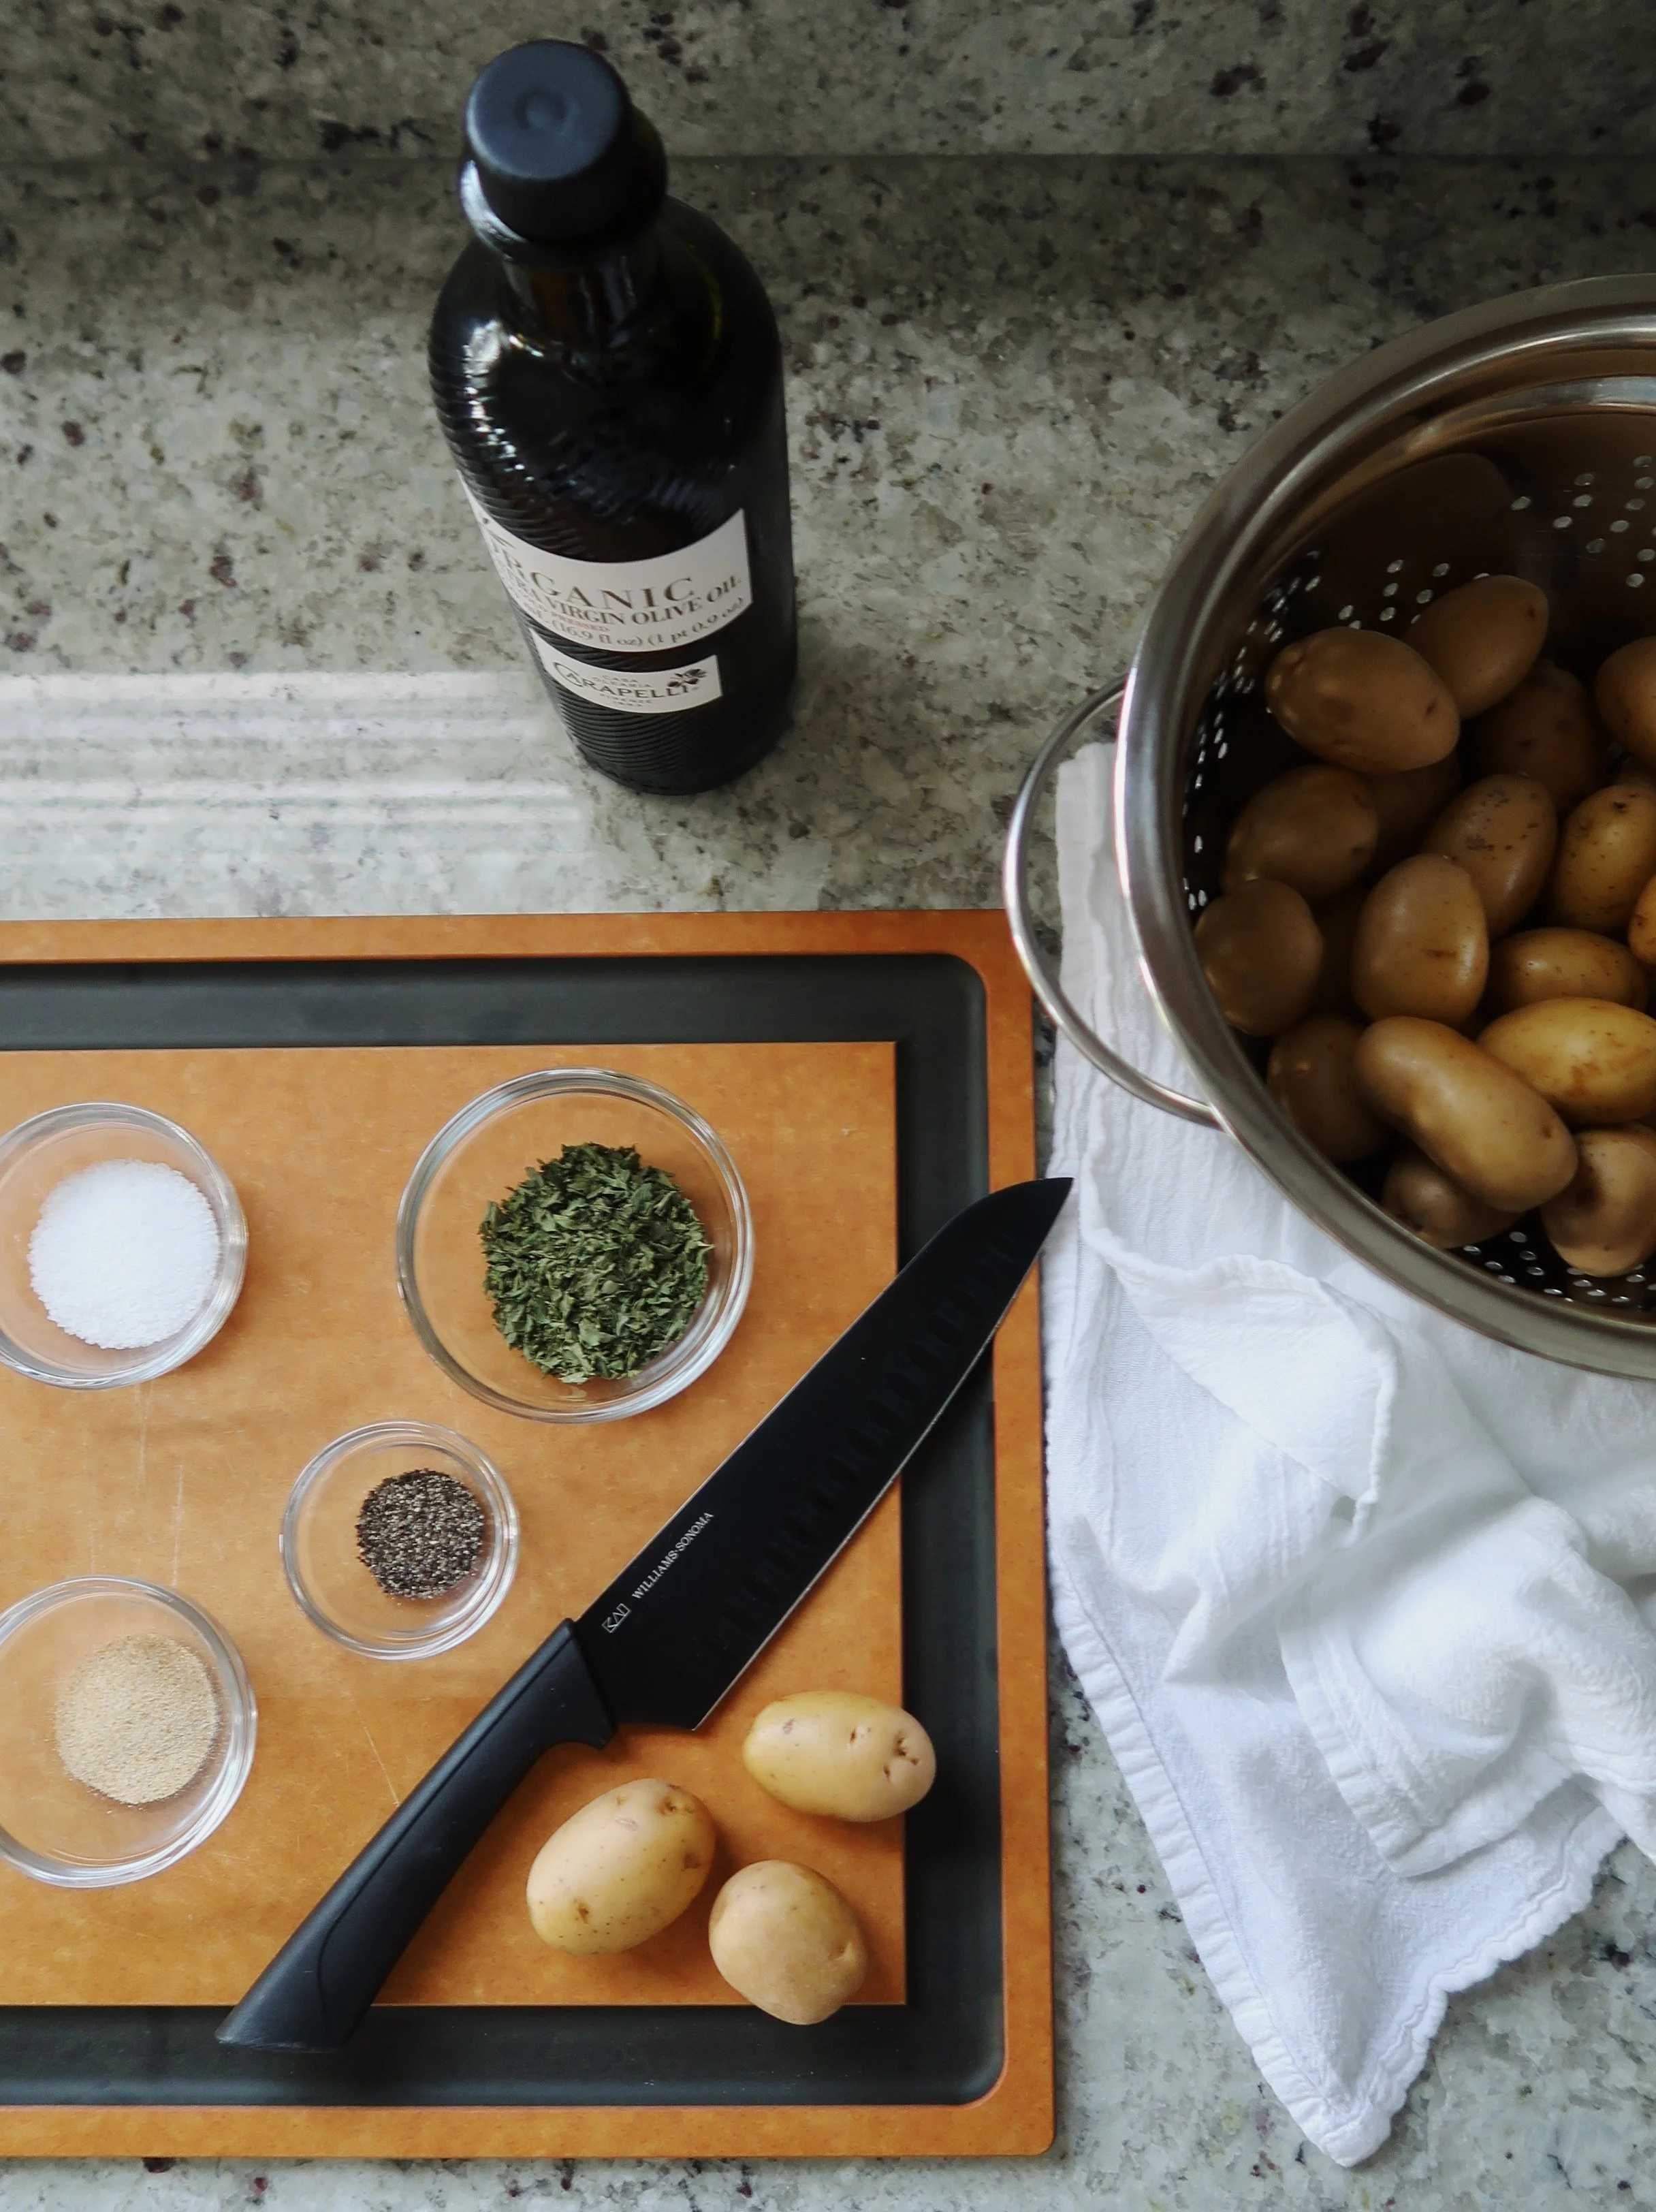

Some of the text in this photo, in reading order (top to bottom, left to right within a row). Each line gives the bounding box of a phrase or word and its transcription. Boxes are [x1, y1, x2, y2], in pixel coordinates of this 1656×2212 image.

[545, 595, 626, 625] VIRGIN
[631, 597, 702, 625] OLIVE
[552, 661, 688, 699] CARAPELLI
